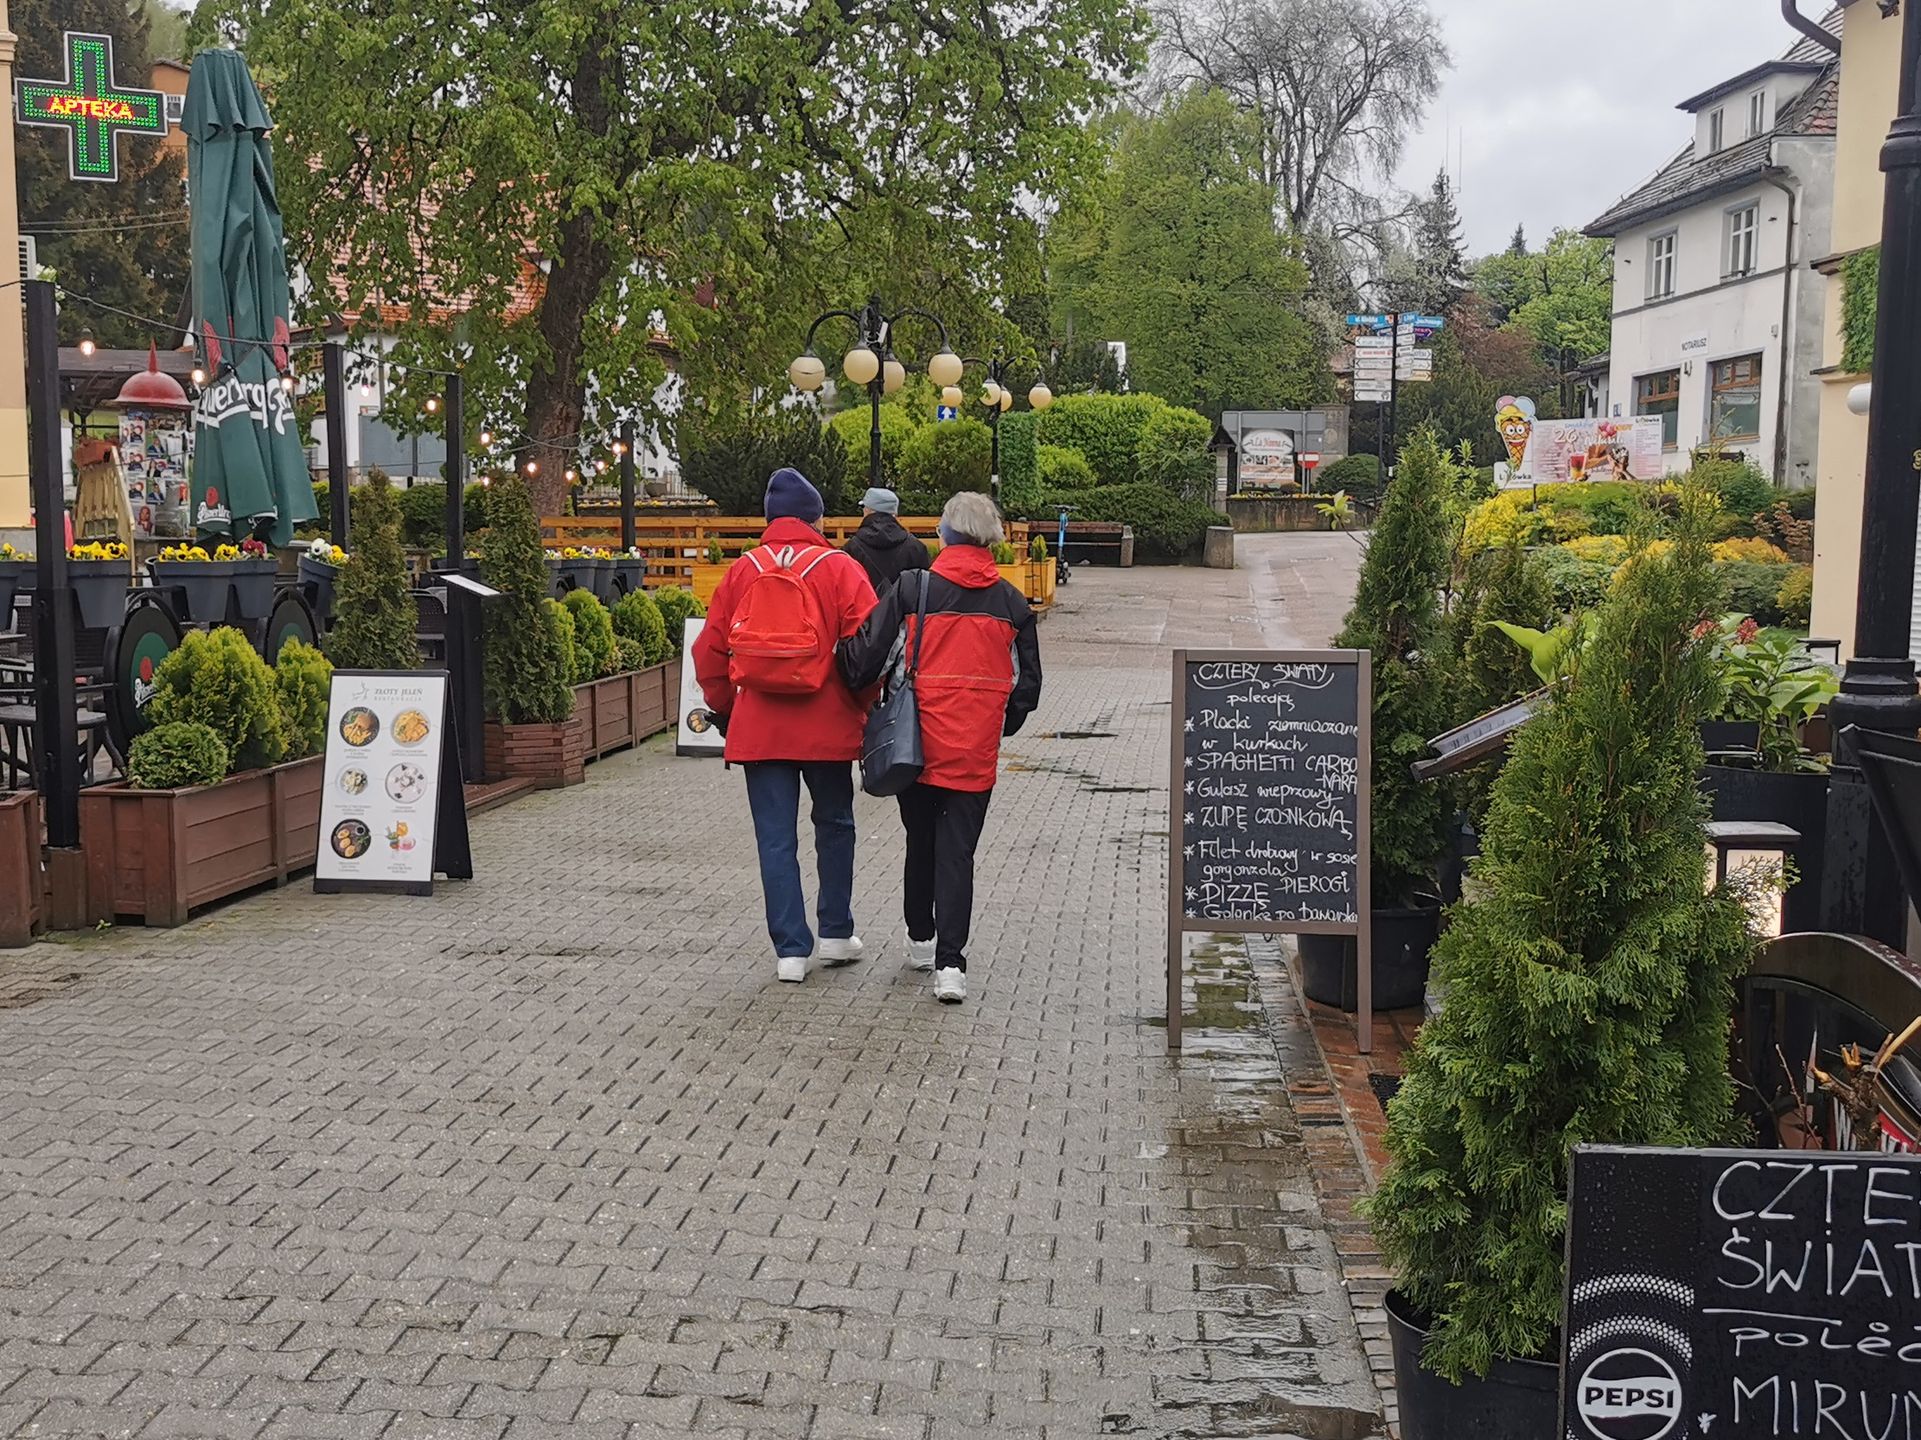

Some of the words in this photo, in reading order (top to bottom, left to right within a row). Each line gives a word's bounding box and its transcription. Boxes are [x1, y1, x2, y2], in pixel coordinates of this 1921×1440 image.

[47, 97, 134, 119] APTEKA
[1681, 338, 1707, 351] NOTARIUSZ
[1554, 427, 1577, 444] 26
[1199, 663, 1261, 682] CZTERY
[1226, 687, 1295, 716] polecają
[1200, 709, 1253, 729] Placki
[1202, 738, 1218, 750] w
[1233, 732, 1308, 751] kurkach
[1197, 751, 1295, 772] SPAGHETTI
[1305, 754, 1358, 774] CARBO
[1257, 784, 1344, 809] wieprzowy
[1198, 837, 1241, 859] Filet
[1245, 840, 1299, 872] drobiowy
[1200, 861, 1287, 883] gorgonzola
[1712, 1161, 1921, 1225] CZTE
[1584, 1386, 1674, 1409] PEPSI
